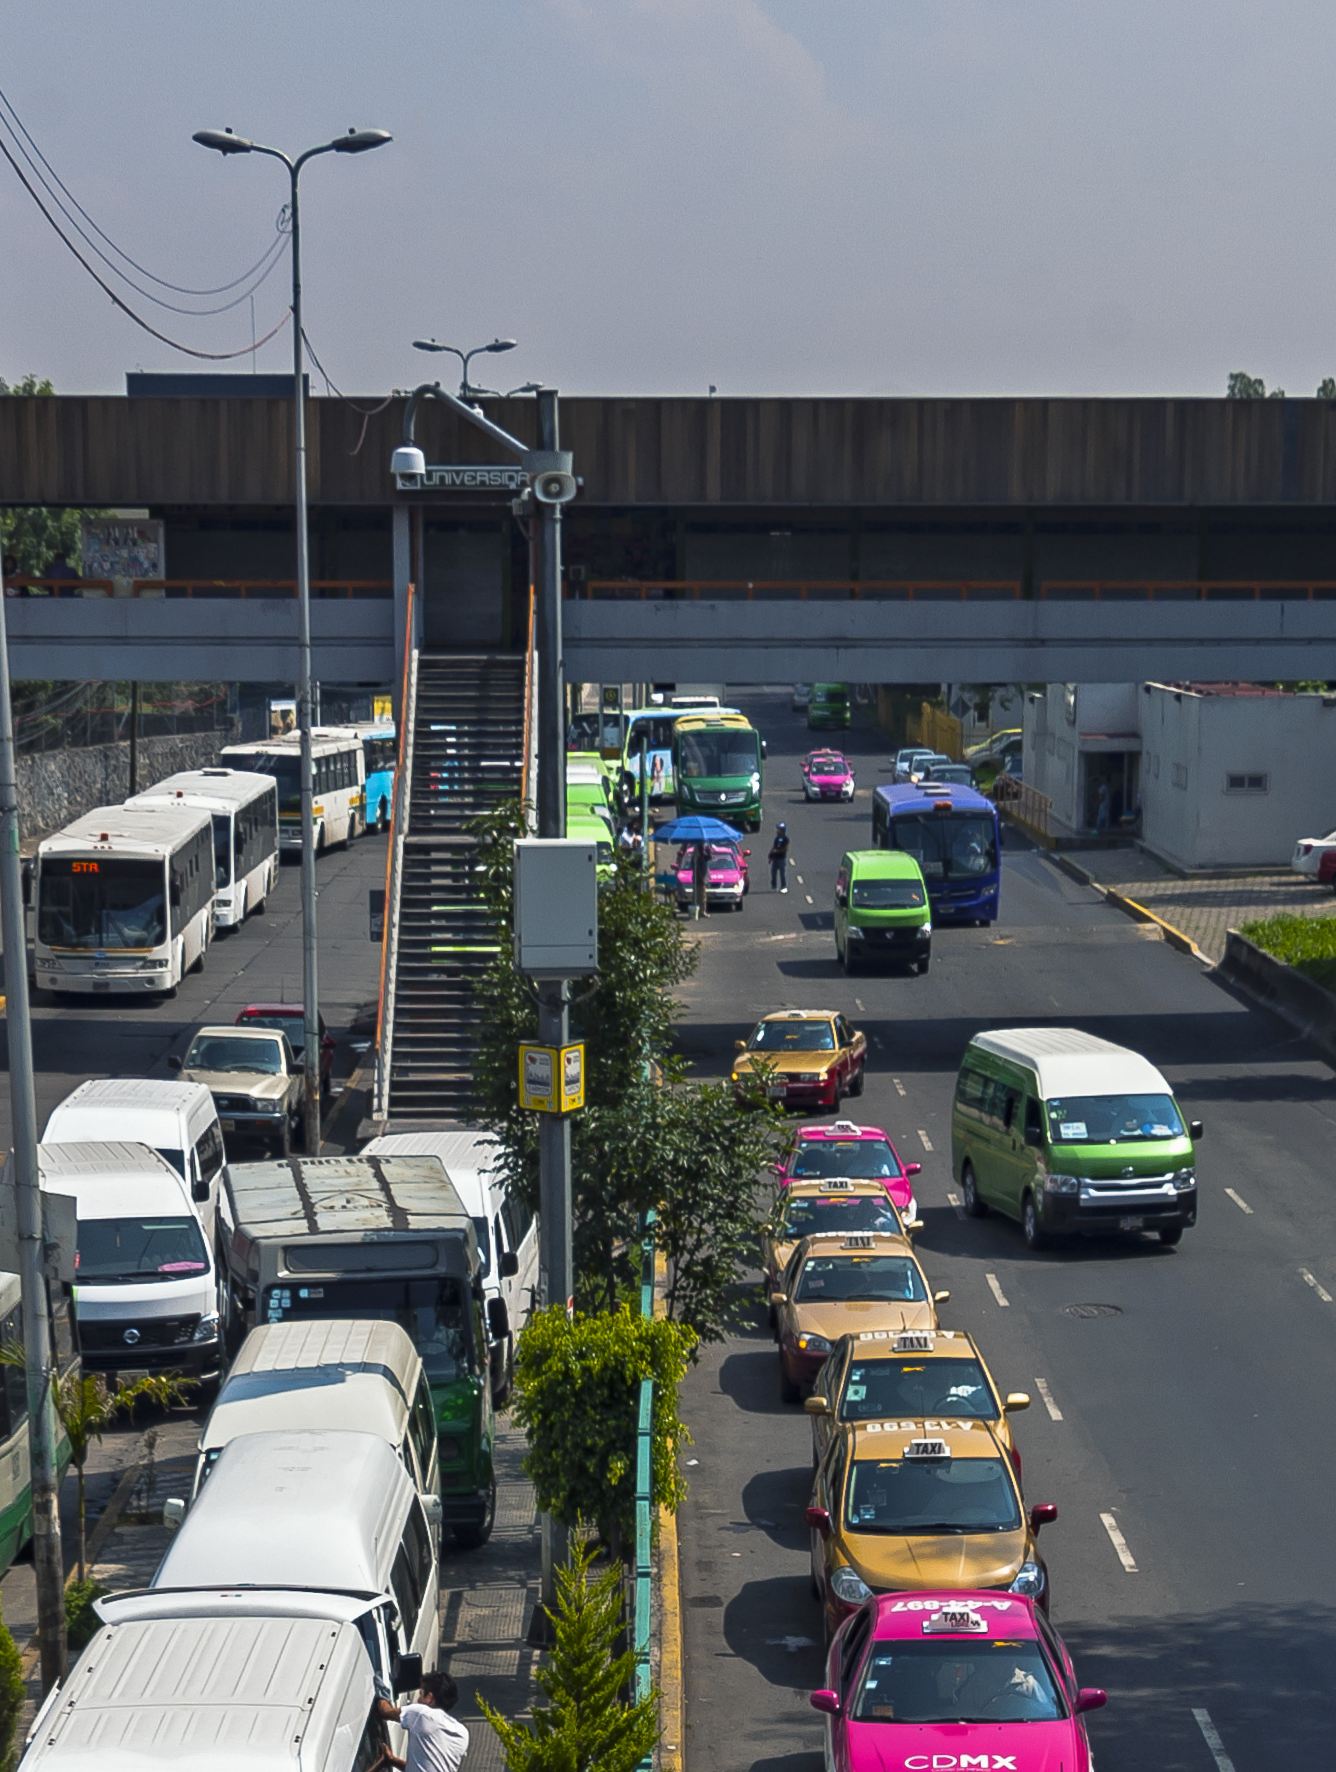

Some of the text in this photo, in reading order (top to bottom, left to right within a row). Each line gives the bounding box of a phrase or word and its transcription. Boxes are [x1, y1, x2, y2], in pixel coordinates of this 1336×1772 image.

[423, 471, 531, 486] UNIVERSIDA
[826, 1181, 849, 1190] TAXI
[900, 1336, 929, 1349] TAXI
[913, 1443, 943, 1456] TAXI
[942, 1612, 969, 1622] TAXI
[904, 1754, 1017, 1770] CDMX
